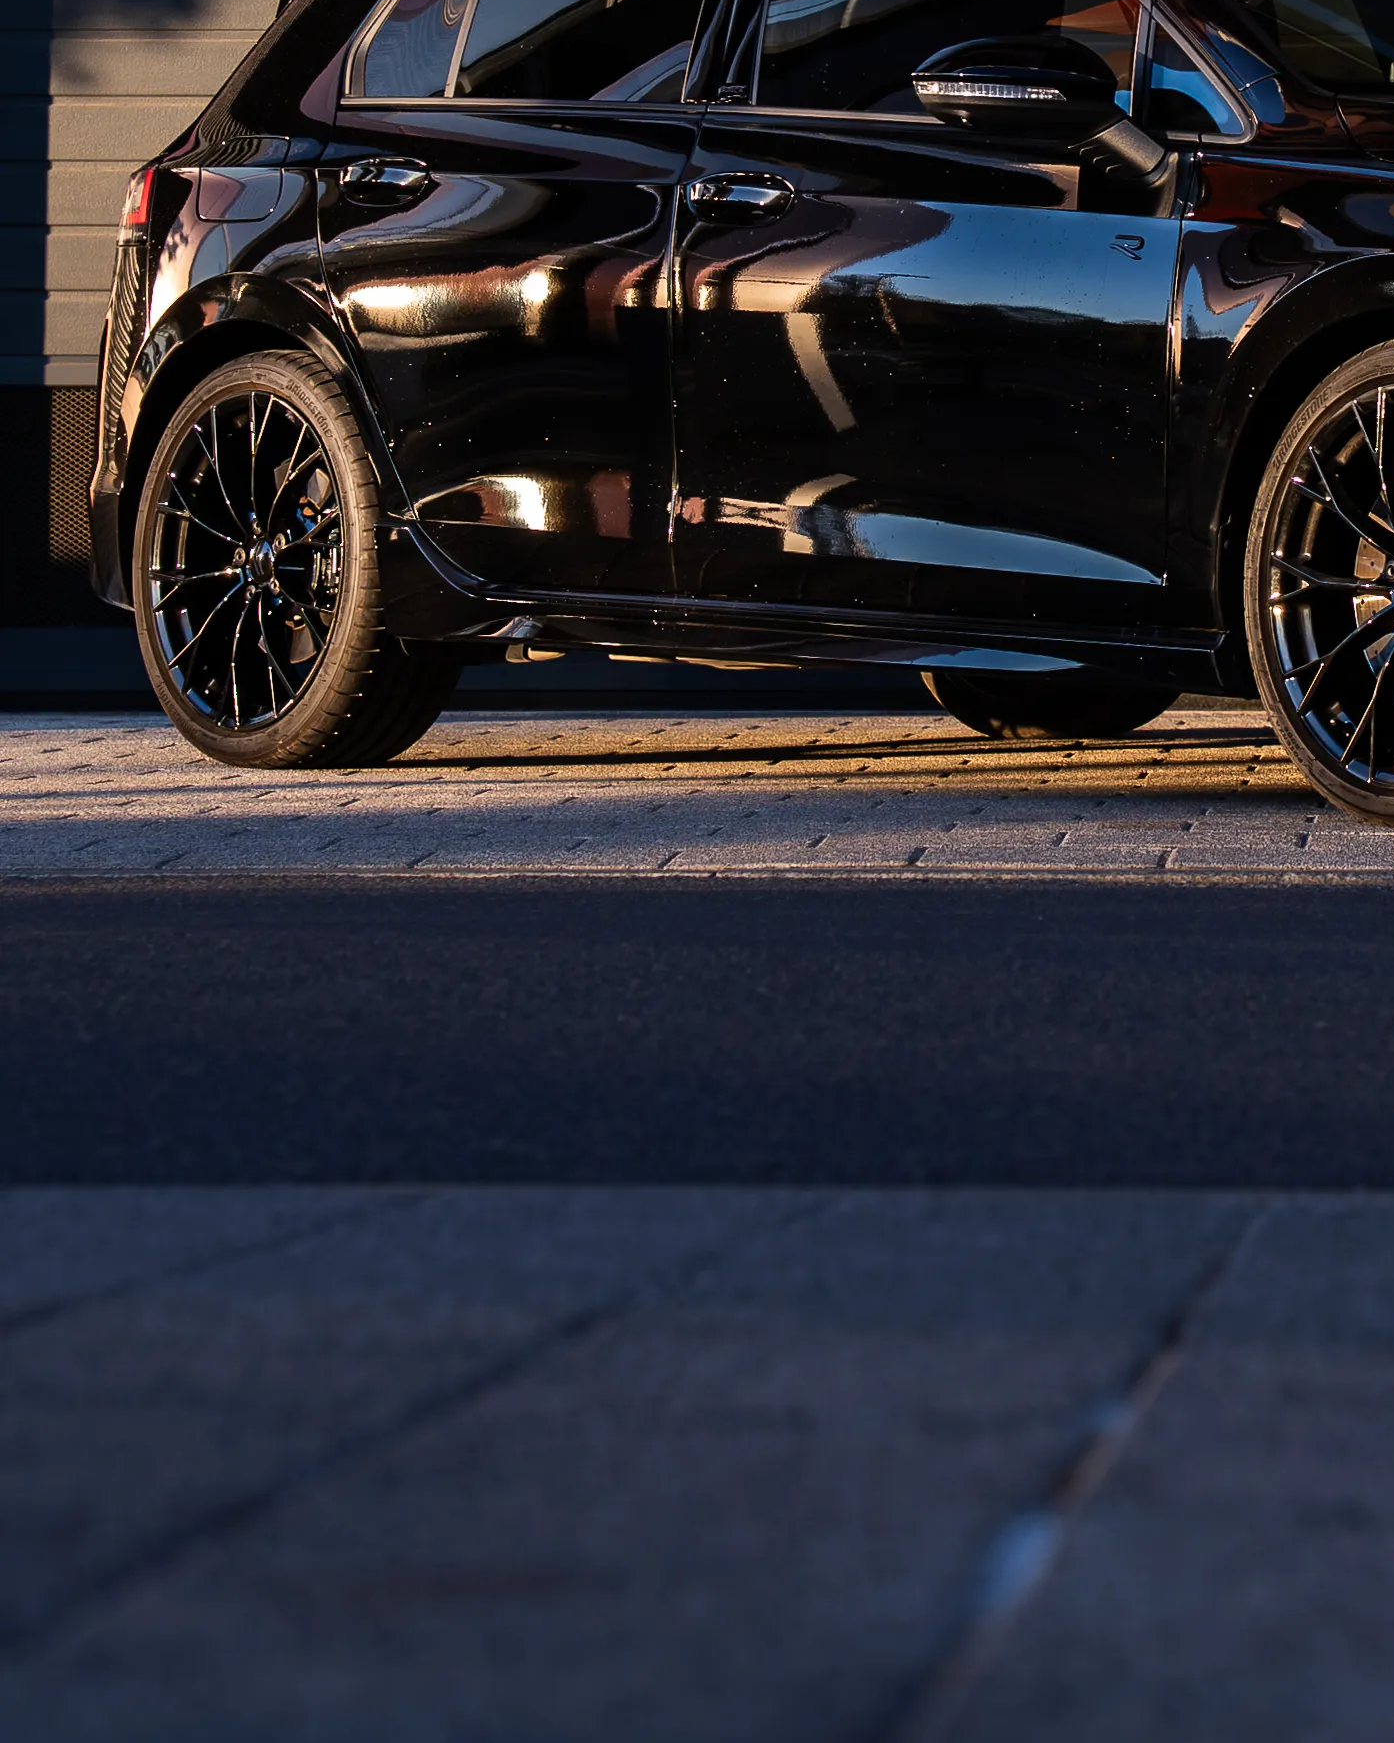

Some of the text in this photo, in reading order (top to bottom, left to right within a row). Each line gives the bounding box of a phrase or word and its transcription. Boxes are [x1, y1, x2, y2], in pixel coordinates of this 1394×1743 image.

[1109, 234, 1145, 260] R
[285, 378, 334, 438] BRIDGESTONE
[1271, 385, 1333, 473] BRIDGESTONE
